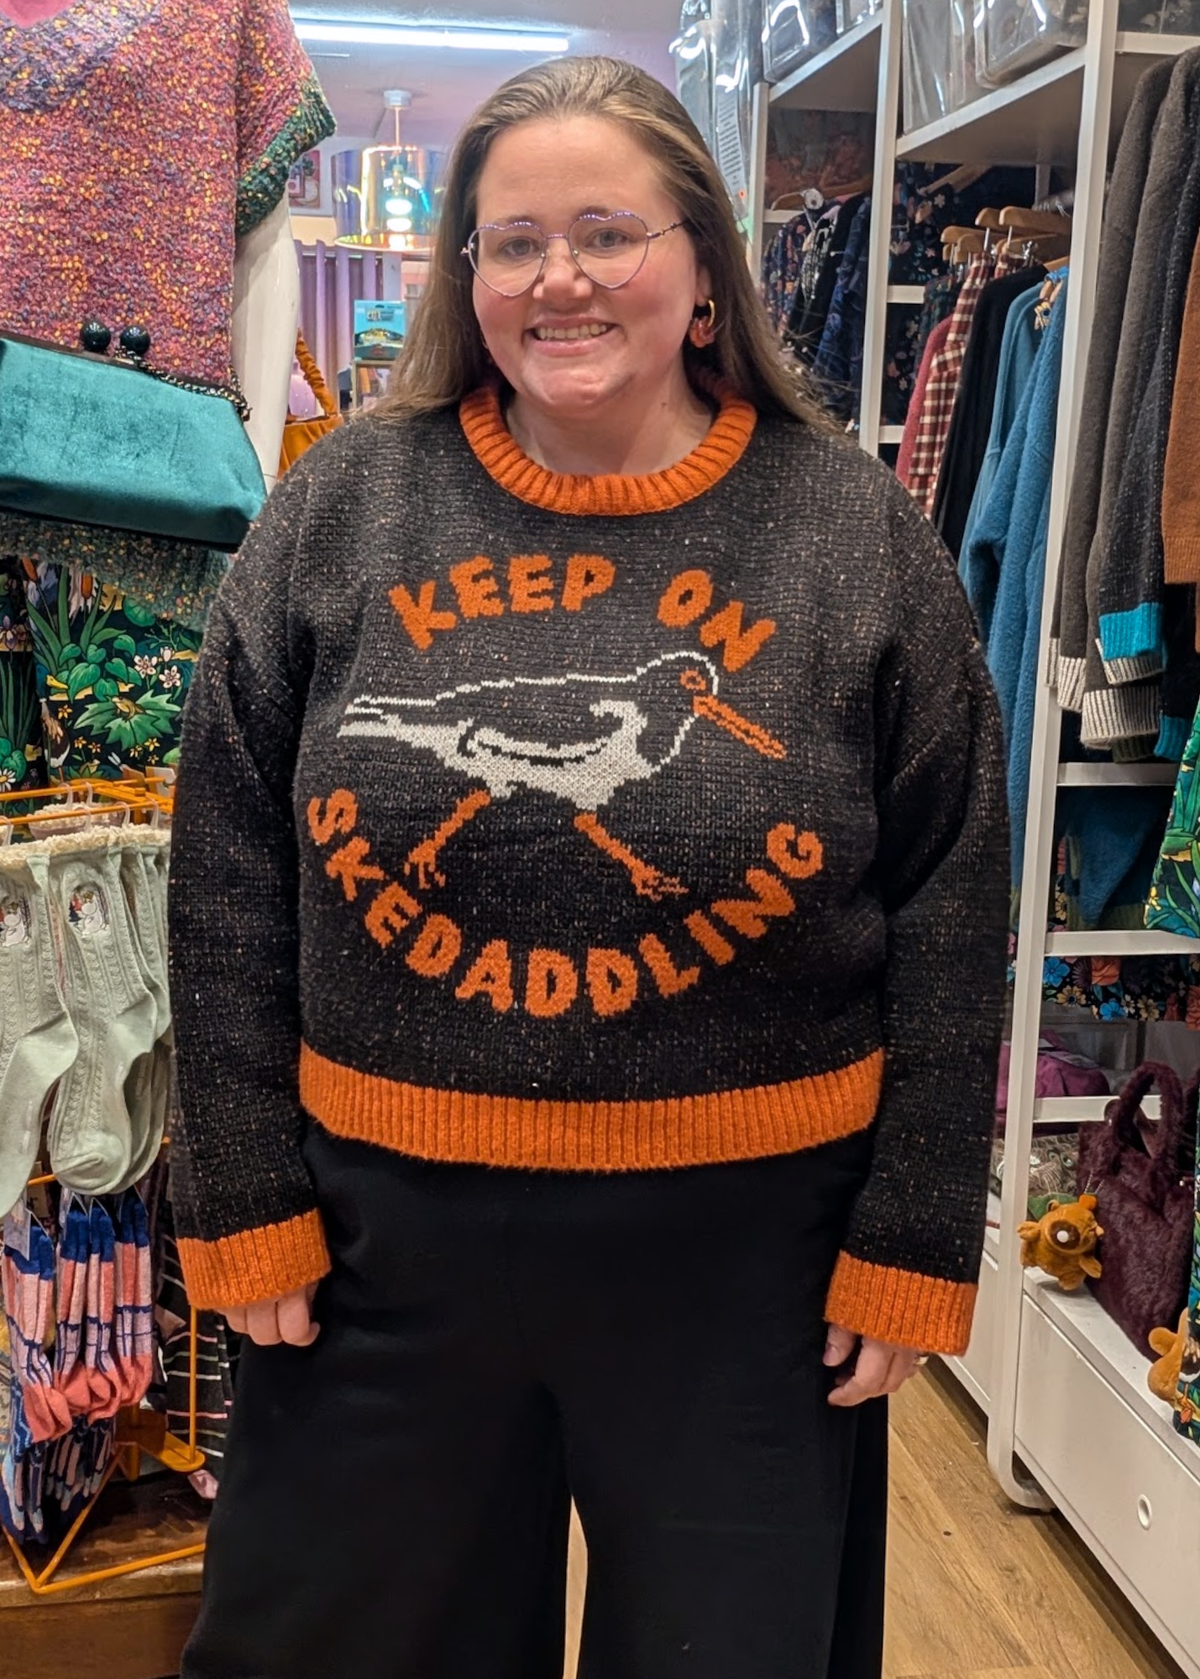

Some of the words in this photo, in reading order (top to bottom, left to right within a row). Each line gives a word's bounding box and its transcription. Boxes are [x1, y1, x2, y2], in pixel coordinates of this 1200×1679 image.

[388, 554, 616, 651] KEEP
[657, 569, 777, 672] ON
[307, 788, 823, 1018] SKEDADDLING
